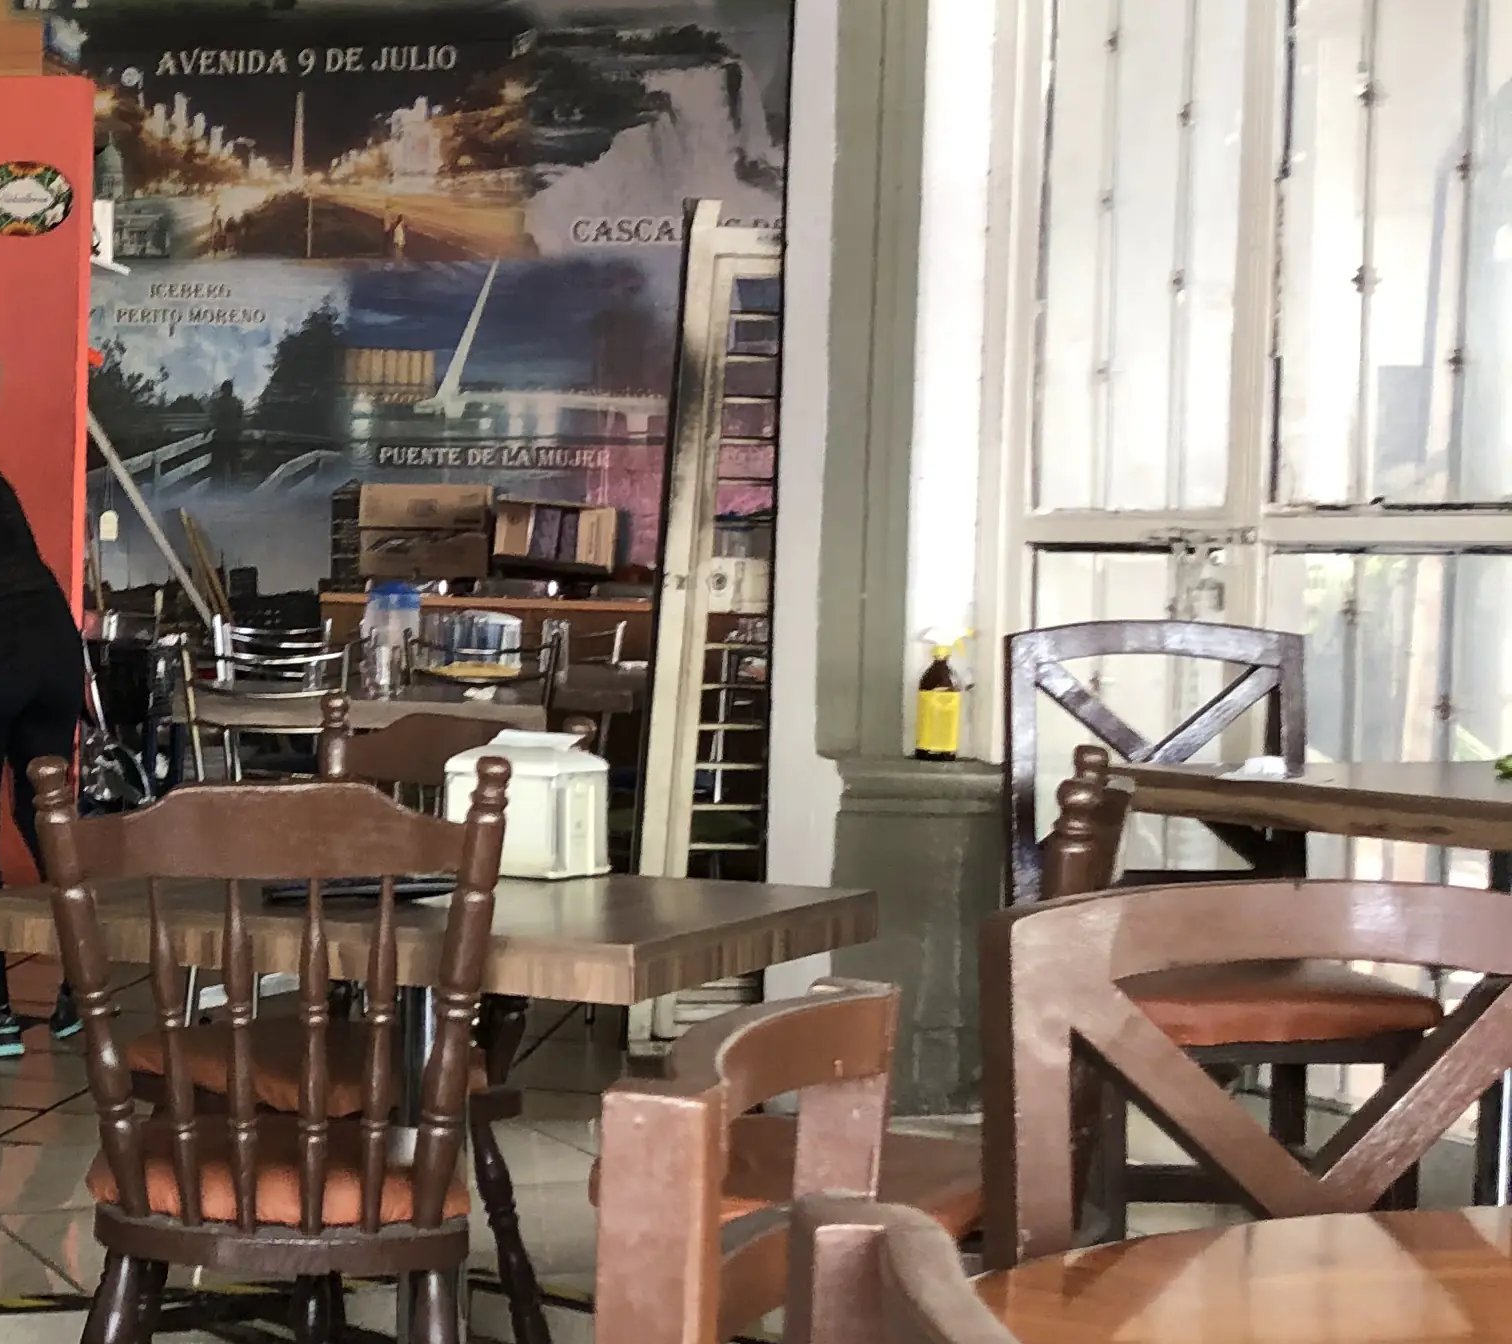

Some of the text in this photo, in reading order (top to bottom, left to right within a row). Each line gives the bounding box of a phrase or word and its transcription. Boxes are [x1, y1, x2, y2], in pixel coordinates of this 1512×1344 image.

[155, 44, 458, 77] AVENIDA 9 DE JULIO
[116, 307, 267, 325] PERITO MORENO
[379, 445, 611, 469] PUENTE DE LA MUJER
